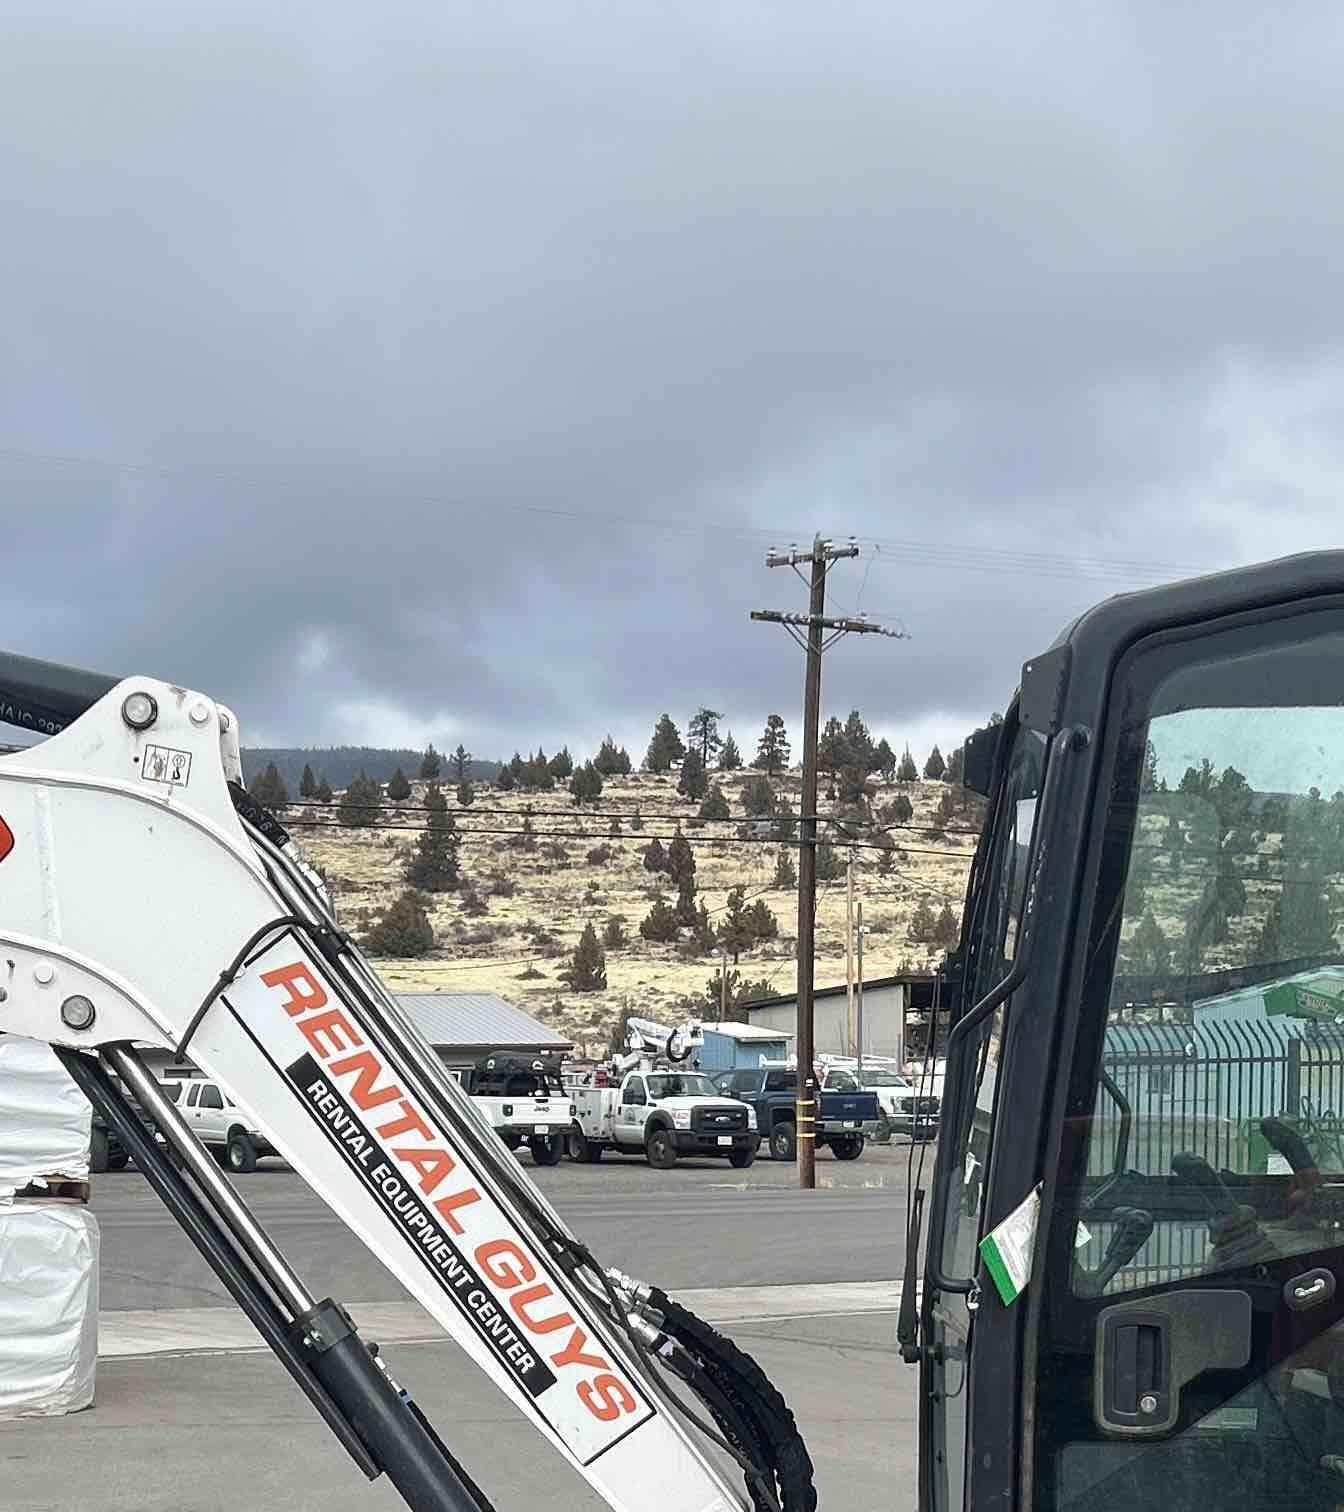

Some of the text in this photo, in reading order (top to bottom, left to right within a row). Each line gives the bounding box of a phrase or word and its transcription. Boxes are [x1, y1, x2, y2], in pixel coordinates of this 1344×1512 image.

[260, 961, 637, 1422] RENTAL GUYS
[306, 1079, 536, 1376] RENTAL EQUIPMENT CENTER
